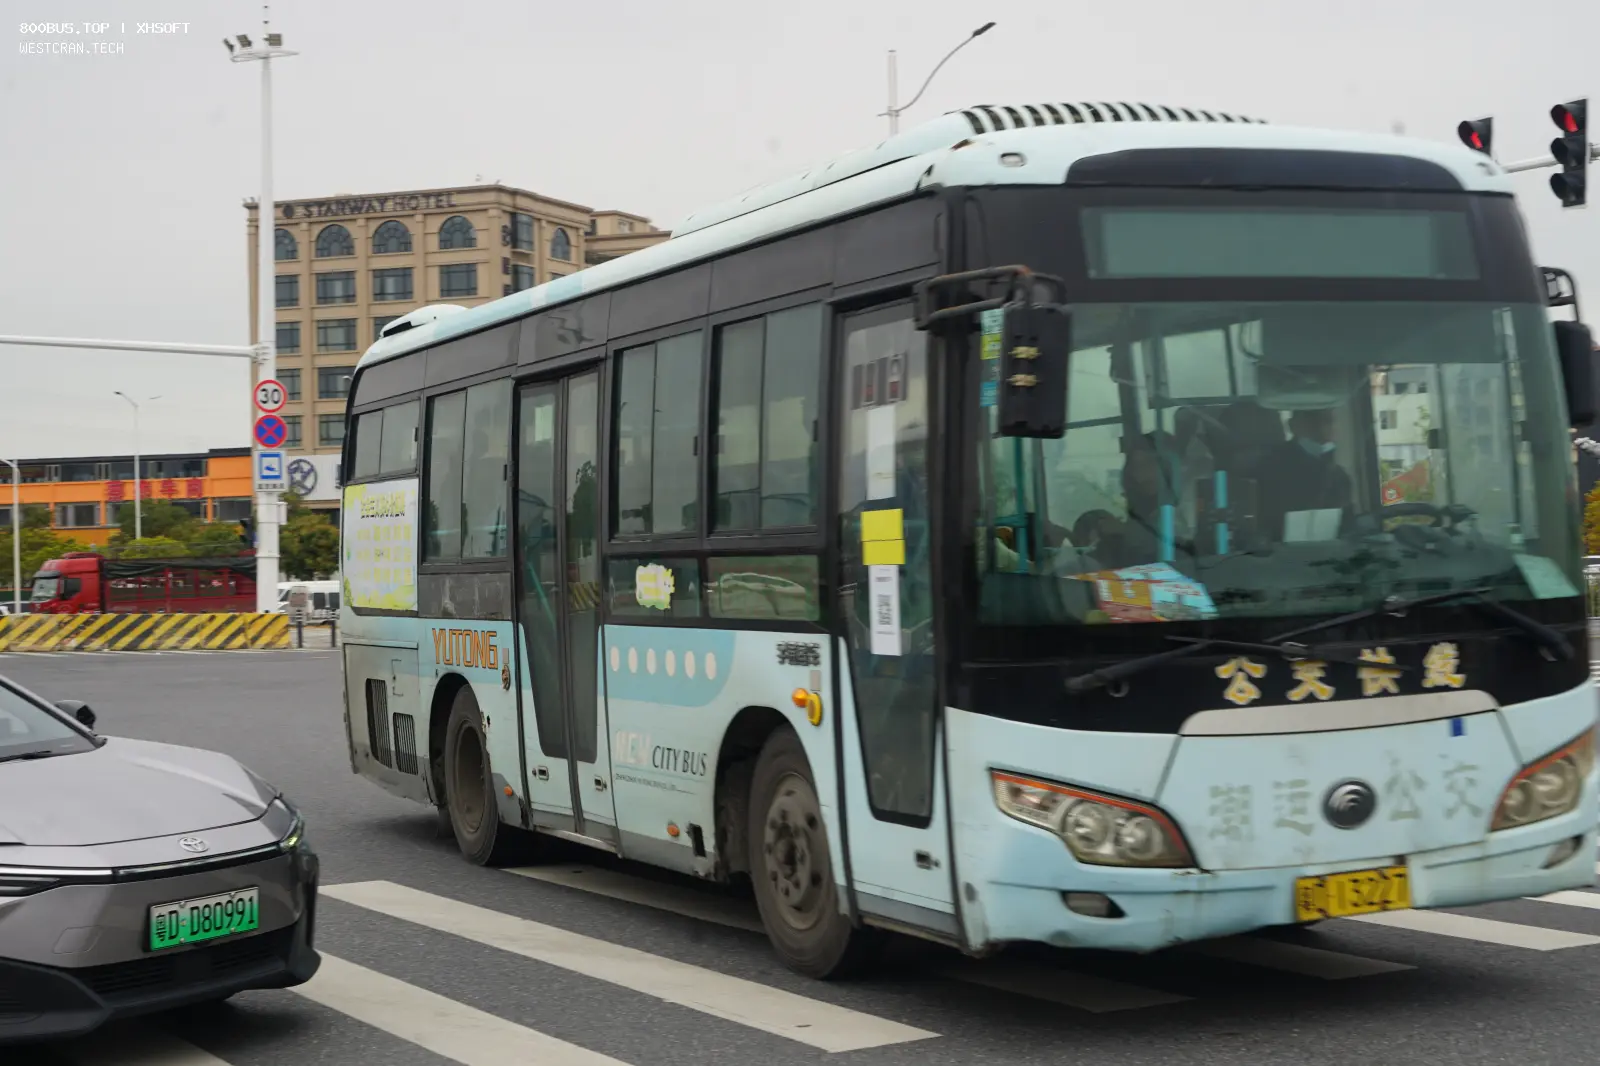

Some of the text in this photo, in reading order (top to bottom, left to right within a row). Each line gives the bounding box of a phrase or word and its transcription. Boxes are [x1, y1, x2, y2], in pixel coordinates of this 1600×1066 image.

[304, 192, 457, 218] STARWAY HOTEL
[260, 387, 282, 405] 30
[431, 627, 499, 671] YUTONG
[652, 744, 708, 777] CITY BUS
